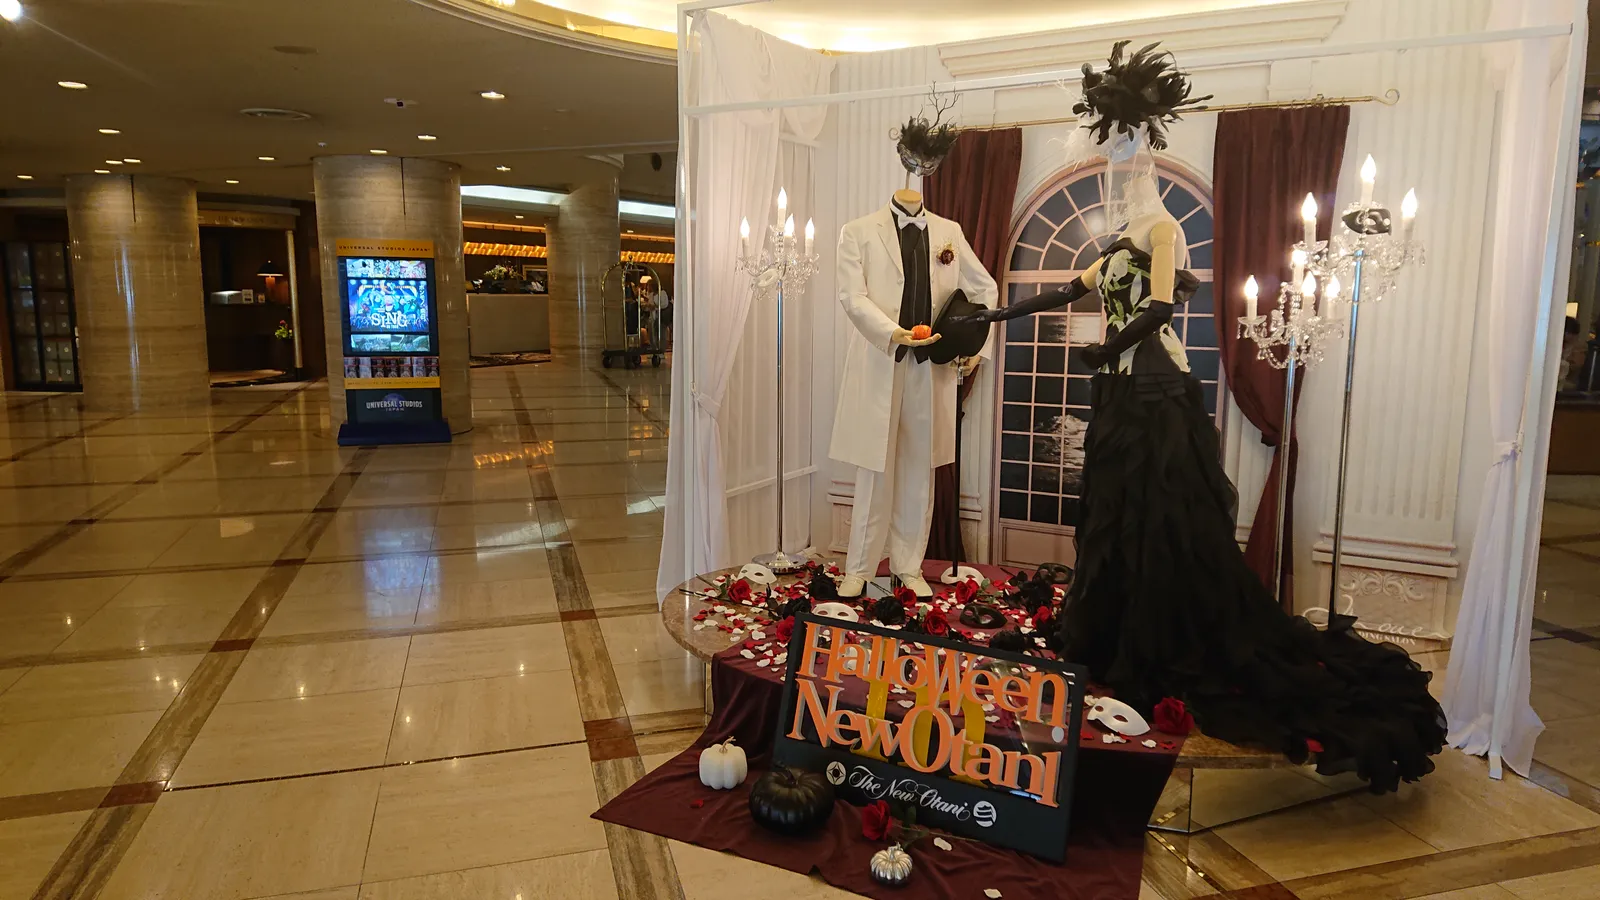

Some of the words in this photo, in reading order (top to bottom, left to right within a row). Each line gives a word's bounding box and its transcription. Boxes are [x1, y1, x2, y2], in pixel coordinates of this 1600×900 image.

[366, 400, 397, 409] UNIVERSAL
[399, 400, 423, 408] STUDIOS
[849, 765, 884, 791] The
[864, 778, 917, 801] New
[915, 783, 971, 821] Otani
